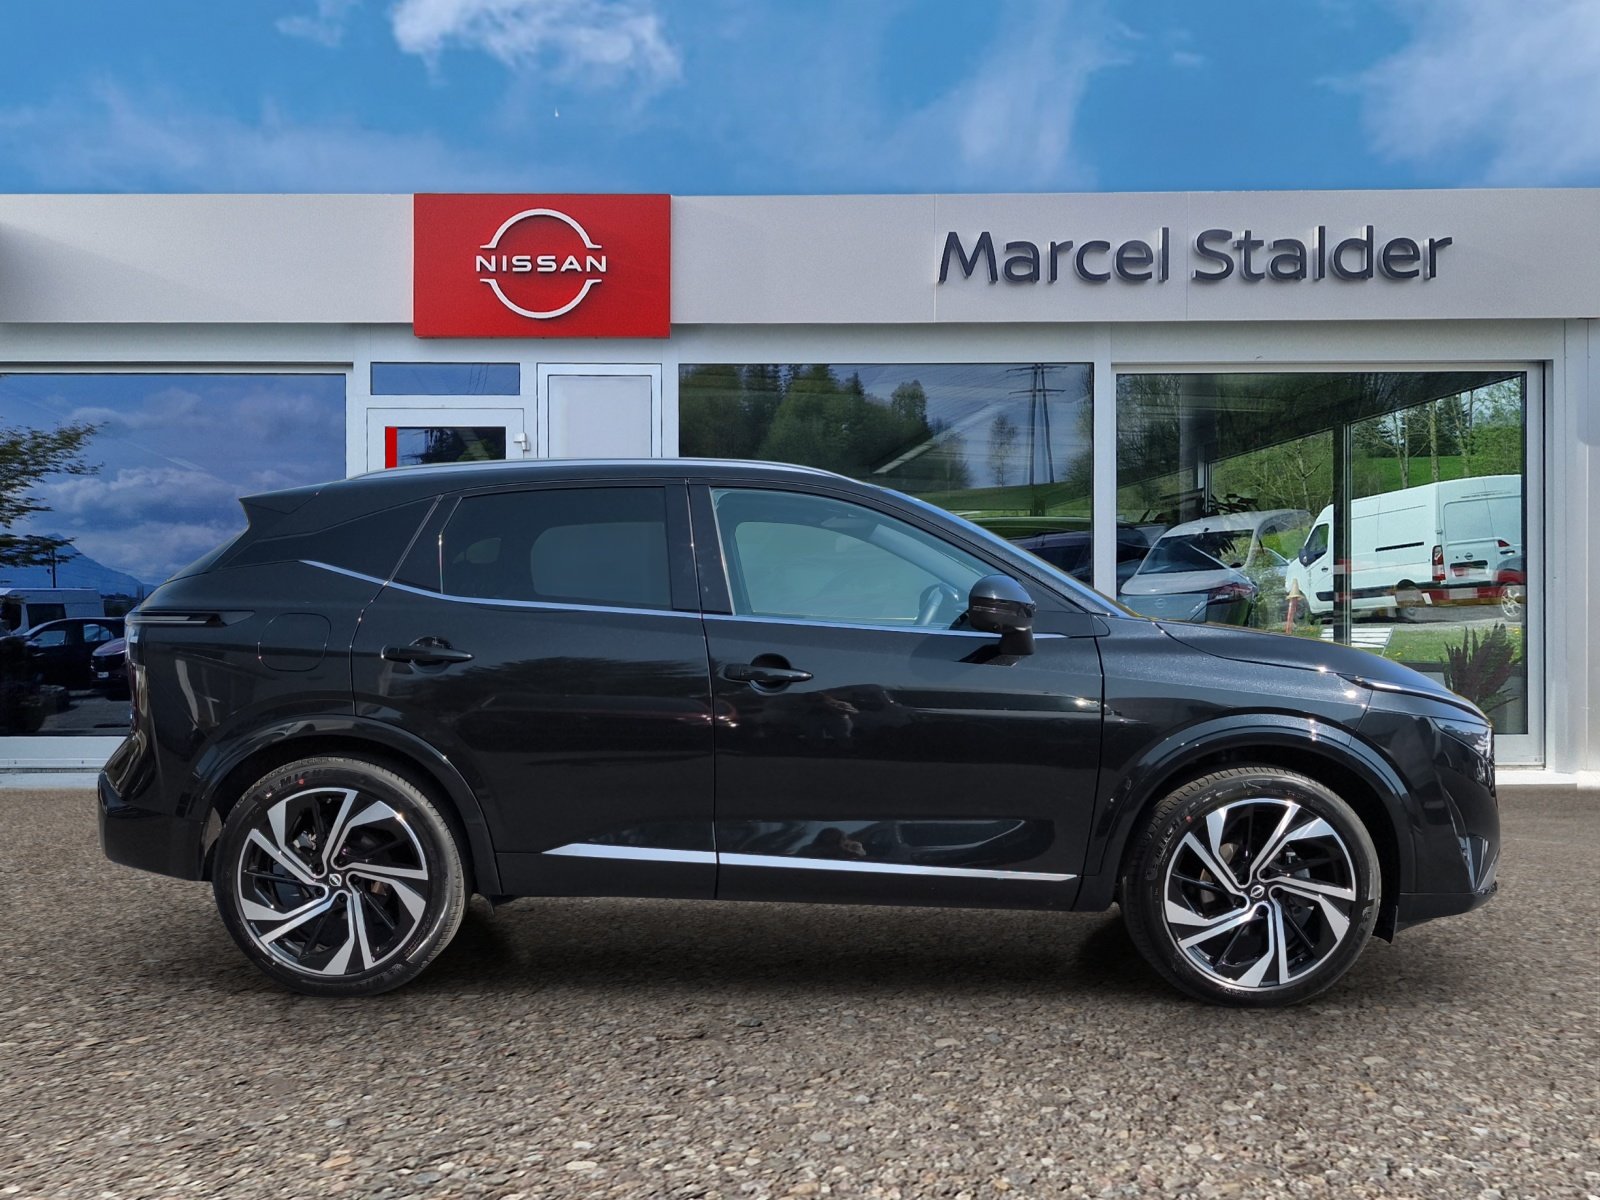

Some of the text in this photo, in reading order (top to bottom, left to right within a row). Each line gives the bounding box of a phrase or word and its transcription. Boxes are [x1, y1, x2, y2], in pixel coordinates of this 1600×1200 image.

[475, 254, 608, 273] NISSAN
[938, 225, 1453, 284] Marcel Stalder
